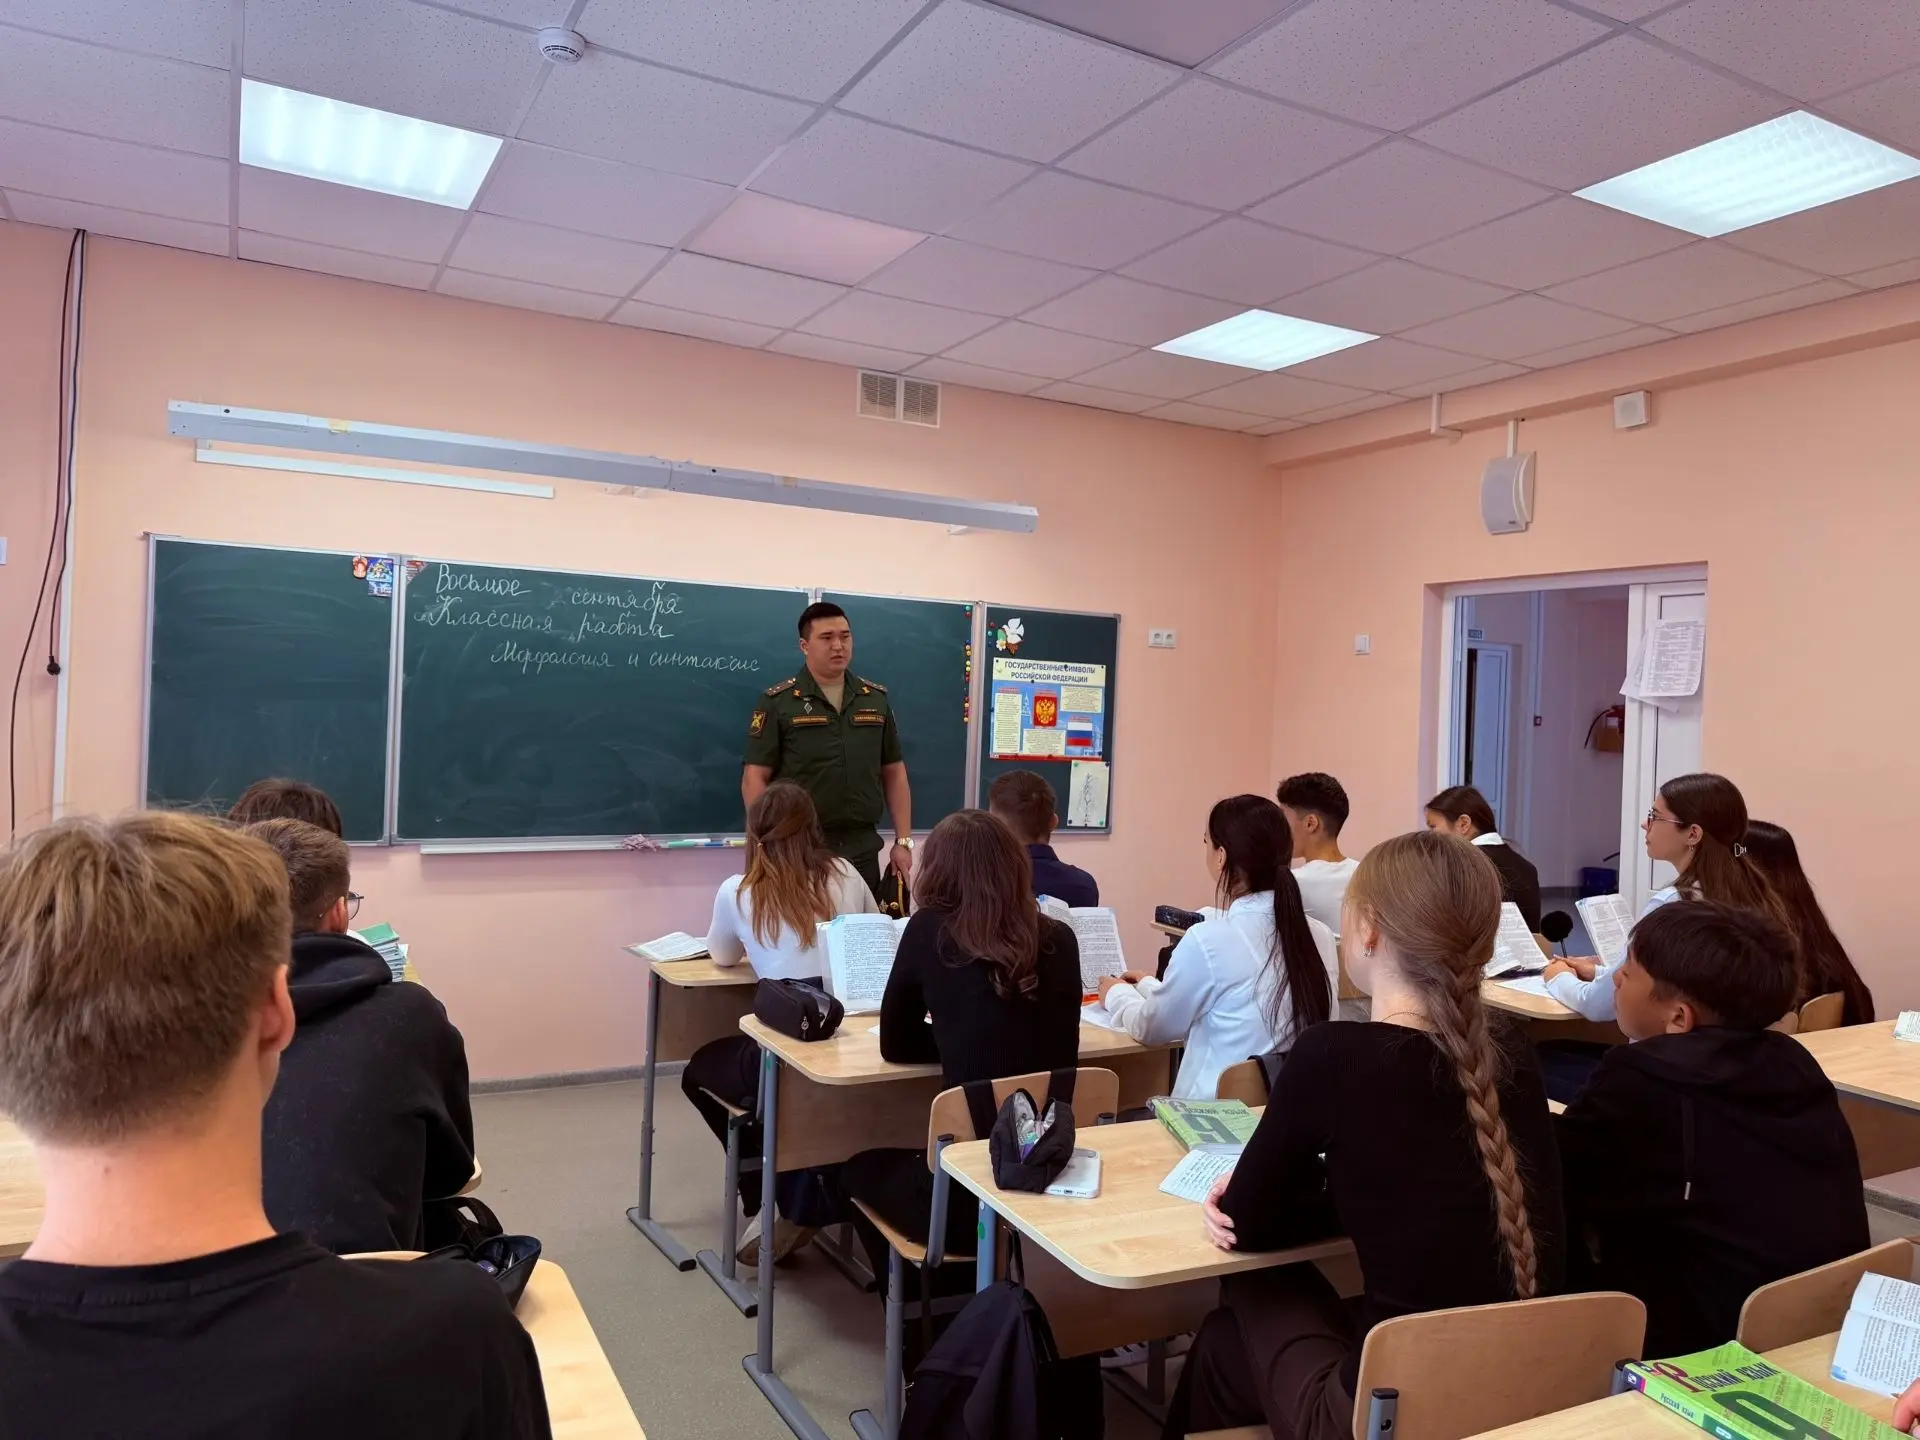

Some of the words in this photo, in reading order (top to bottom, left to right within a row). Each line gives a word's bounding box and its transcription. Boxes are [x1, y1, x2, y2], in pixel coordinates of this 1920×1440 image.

[436, 563, 531, 596] Восьмое
[572, 582, 683, 629] сентября
[428, 595, 553, 632] Классная
[576, 612, 674, 643] работа
[628, 653, 639, 667] и
[650, 651, 760, 671] синтаксис
[1004, 661, 1064, 672] ГОСУДАРСТВЕННЫЕ
[1064, 665, 1096, 673] СИМВОЛЫ
[1011, 671, 1052, 681] РОССИЙСКОЙ
[1052, 674, 1088, 683] ФЕДЕРАЦИИ
[1653, 1361, 1745, 1393] Русский
[1735, 1361, 1781, 1381] язык
